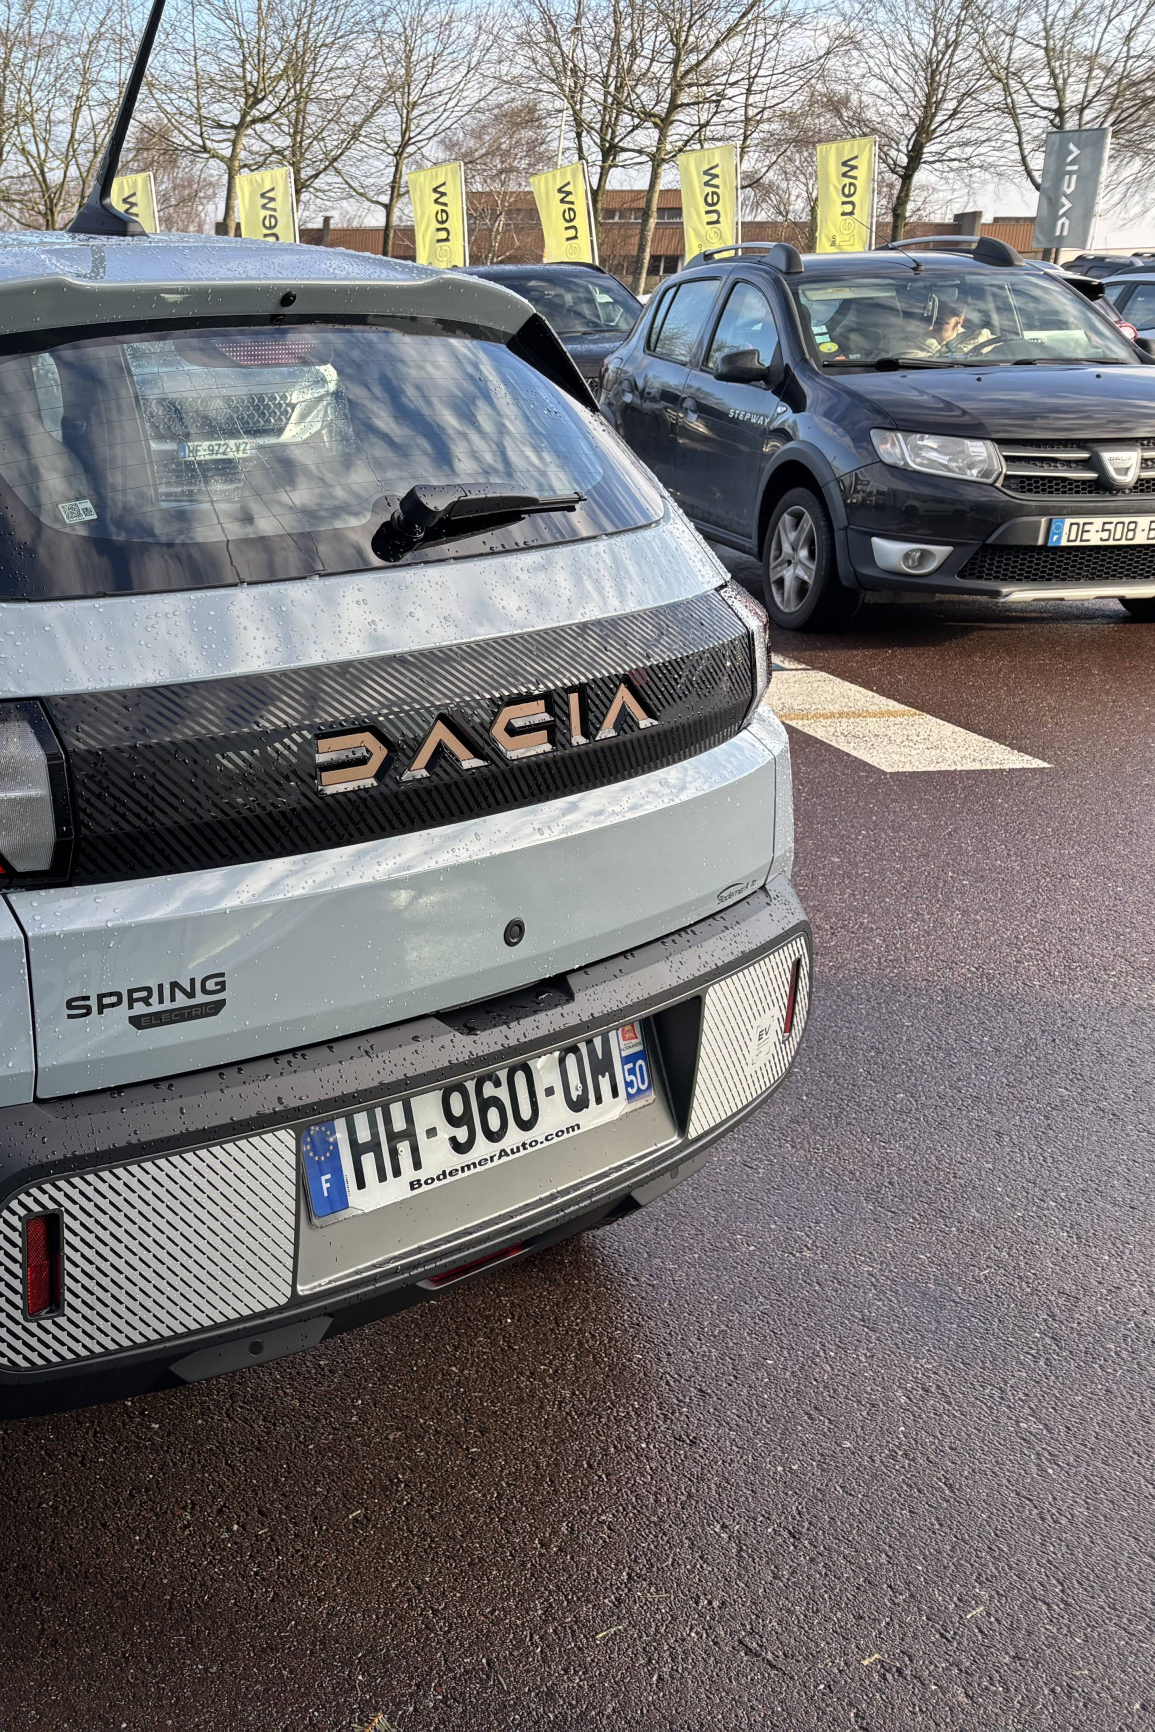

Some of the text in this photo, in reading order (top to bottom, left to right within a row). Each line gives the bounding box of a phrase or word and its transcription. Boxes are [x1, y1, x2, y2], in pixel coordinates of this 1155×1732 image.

[728, 409, 770, 426] STEPWAY
[315, 680, 660, 797] DACIA
[65, 972, 227, 1019] SPRING
[141, 1004, 216, 1026] ELECTRIC
[758, 1024, 771, 1041] EV
[624, 1059, 649, 1095] 50
[346, 1029, 620, 1191] HH-960-QM
[409, 1121, 582, 1192] BodemerAuto.com
[321, 1173, 332, 1197] F
